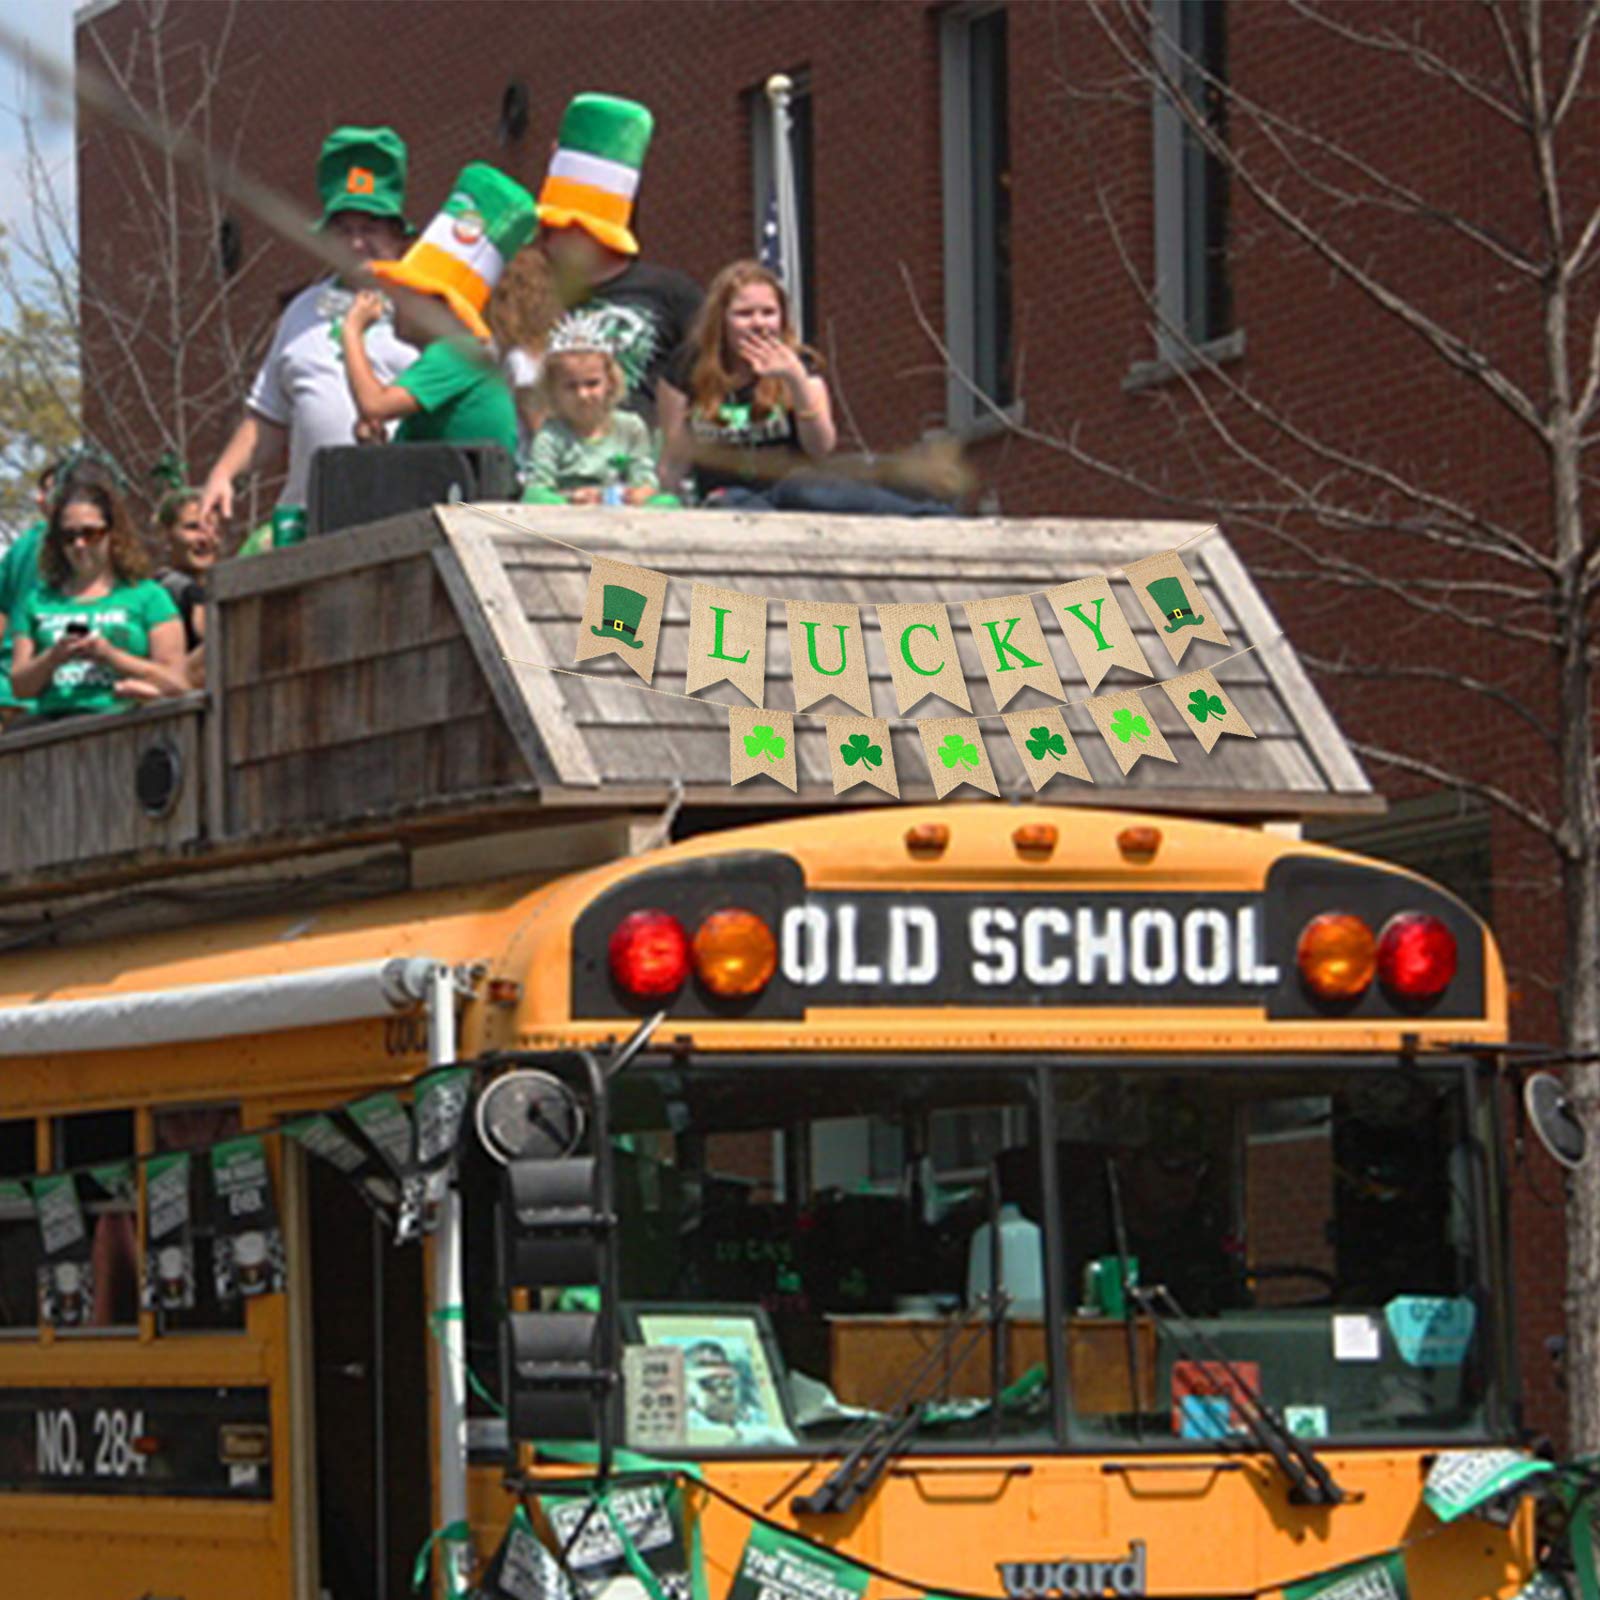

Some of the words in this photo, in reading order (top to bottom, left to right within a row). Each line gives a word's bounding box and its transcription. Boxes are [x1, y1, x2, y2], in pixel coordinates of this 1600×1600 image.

[708, 598, 1115, 677] LUCKY
[781, 905, 938, 984] OLD
[970, 906, 1279, 984] SCHOOL
[35, 1409, 84, 1476] NO.
[94, 1409, 146, 1477] 284
[995, 1539, 1146, 1598] ward
